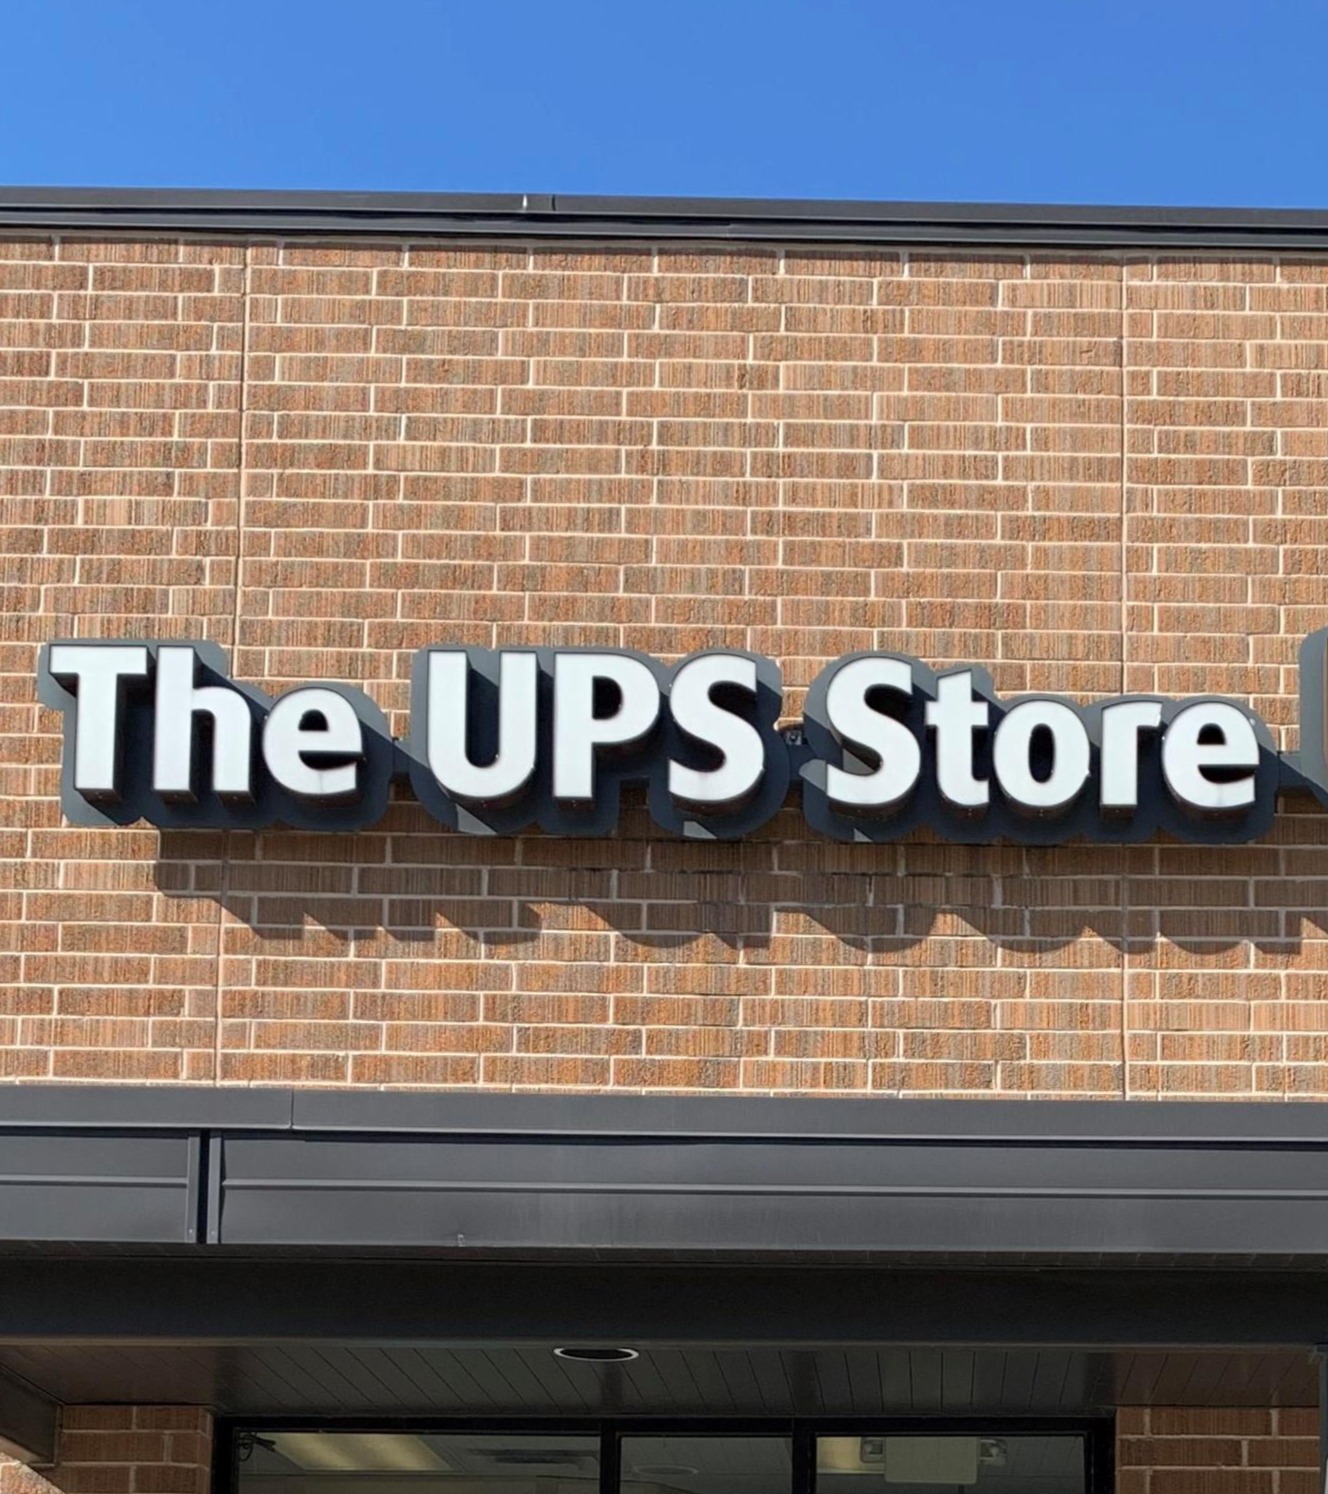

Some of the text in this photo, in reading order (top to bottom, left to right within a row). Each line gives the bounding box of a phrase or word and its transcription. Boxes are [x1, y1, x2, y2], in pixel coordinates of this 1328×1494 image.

[48, 644, 1261, 809] The UPS Store
